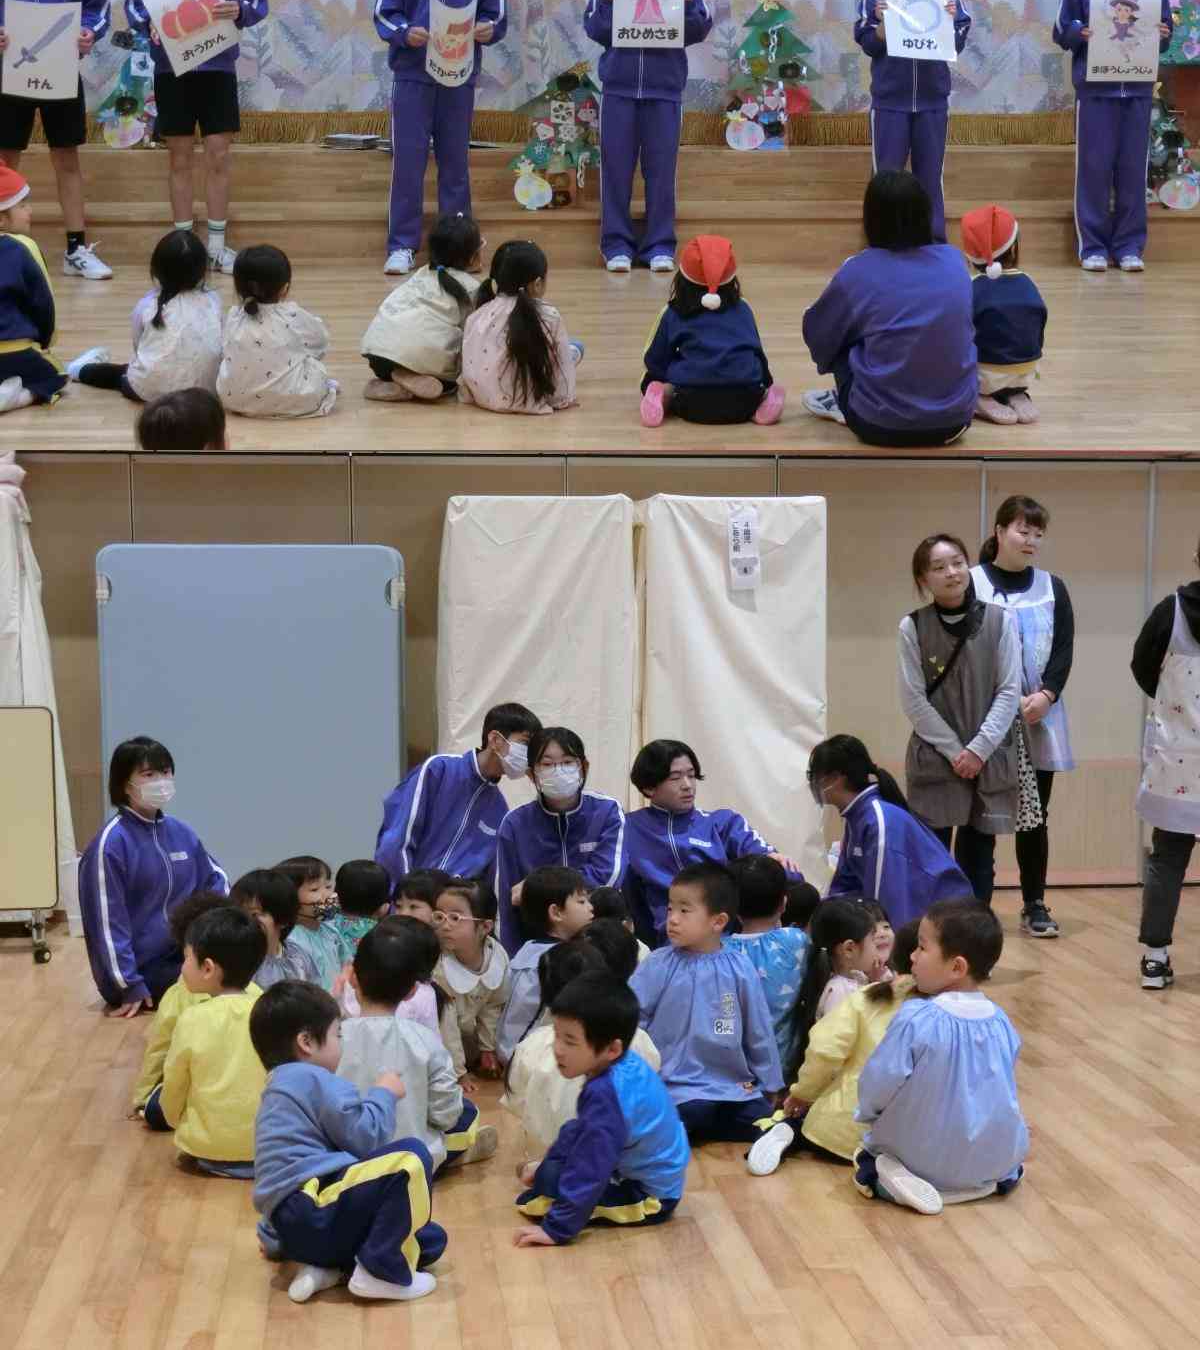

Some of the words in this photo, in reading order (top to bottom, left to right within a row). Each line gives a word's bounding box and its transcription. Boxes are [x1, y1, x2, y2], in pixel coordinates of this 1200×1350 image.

[617, 27, 680, 41] おひめさま
[181, 33, 227, 62] おうかん
[902, 37, 938, 51] ゆびわ
[27, 77, 54, 91] けん
